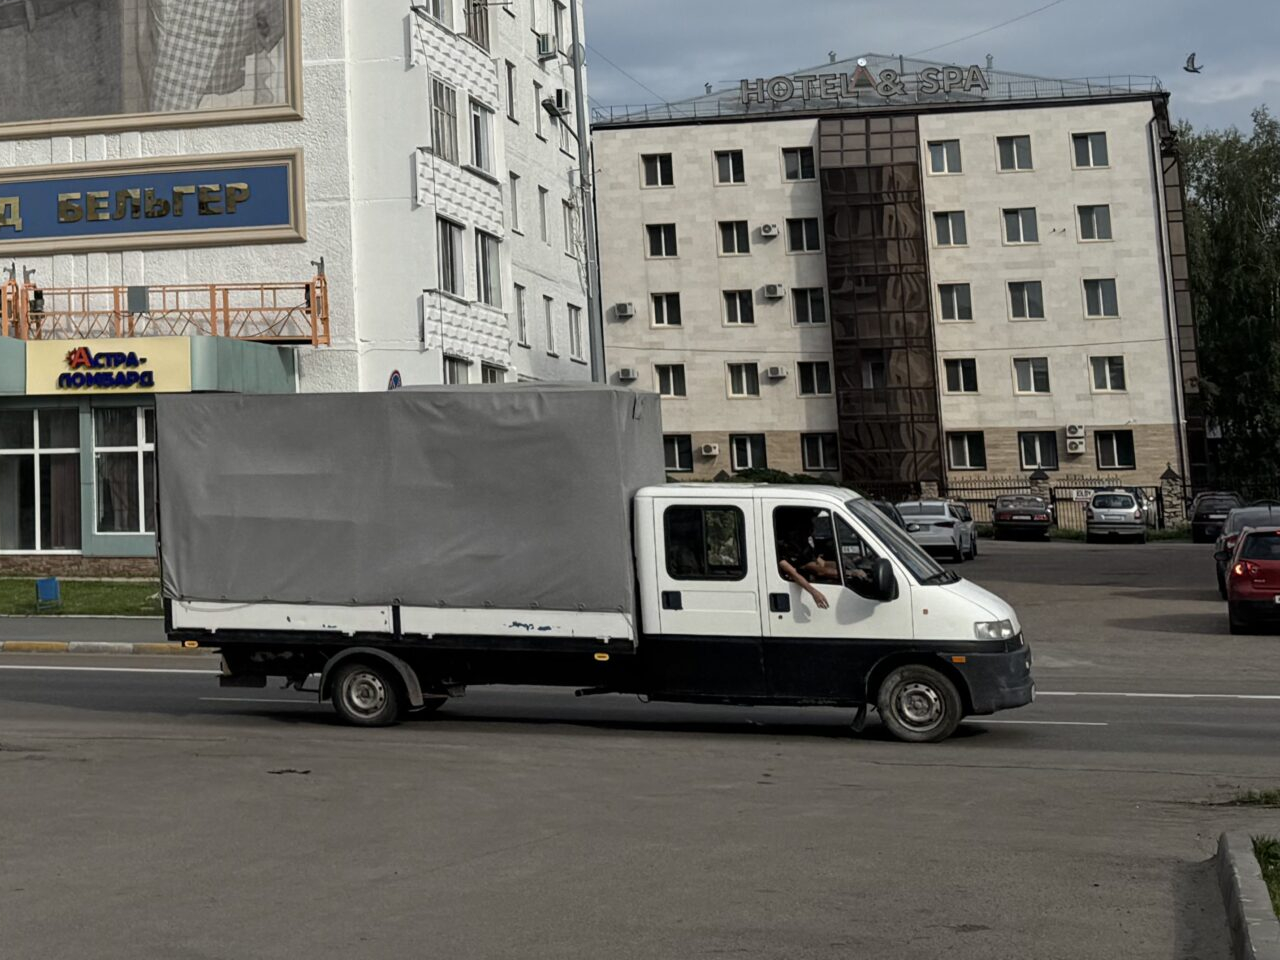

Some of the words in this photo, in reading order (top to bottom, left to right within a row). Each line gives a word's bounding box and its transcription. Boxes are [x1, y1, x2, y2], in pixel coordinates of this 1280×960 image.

[740, 73, 859, 104] HOTEL
[877, 68, 908, 97] &
[920, 65, 989, 94] SPA
[57, 182, 252, 224] БЕЛЬГЕР
